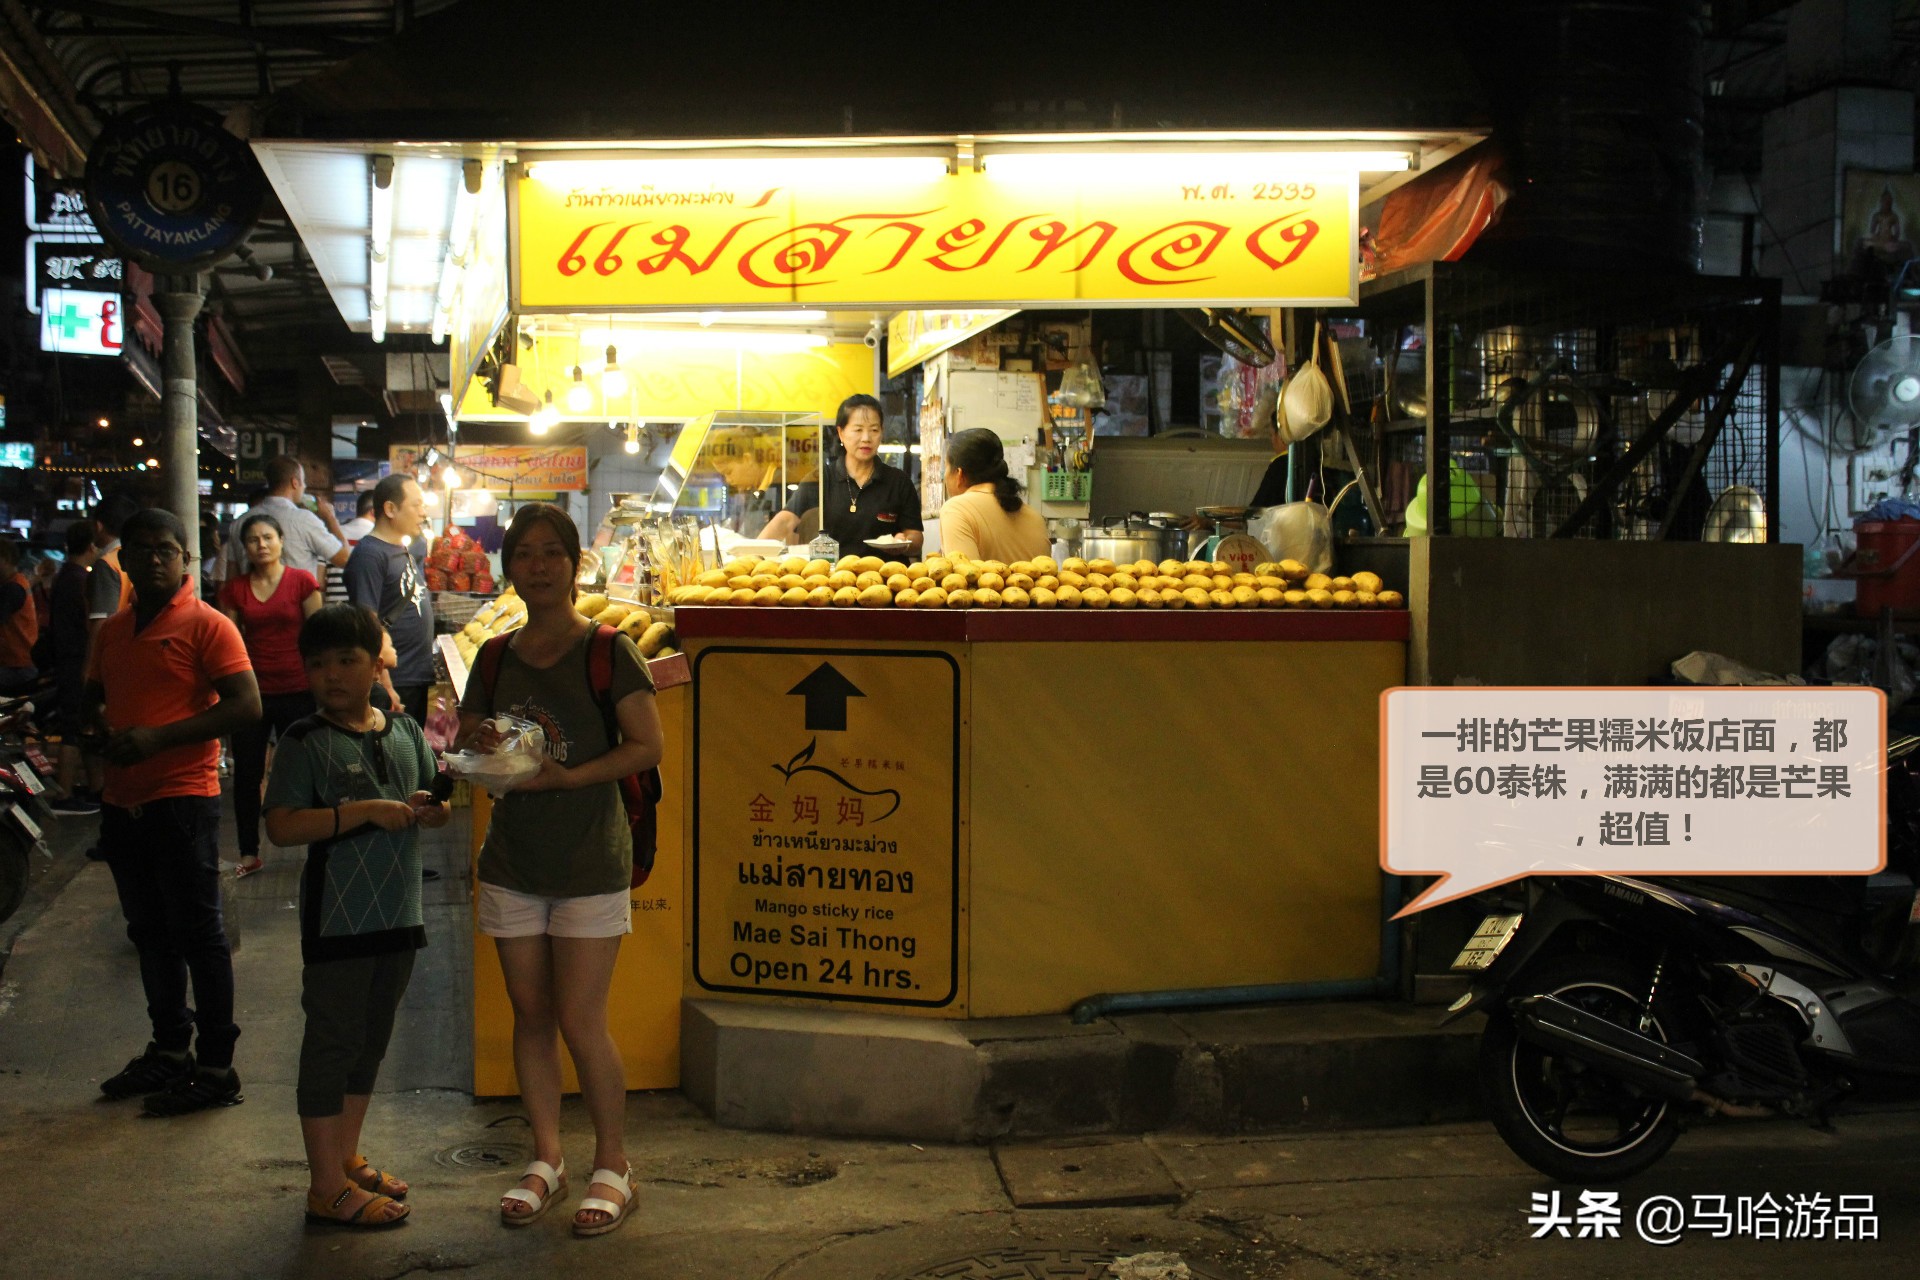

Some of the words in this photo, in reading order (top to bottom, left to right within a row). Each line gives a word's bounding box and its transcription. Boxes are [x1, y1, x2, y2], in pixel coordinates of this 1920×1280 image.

[157, 173, 192, 201] 16
[1253, 183, 1316, 200] 2535
[117, 201, 232, 245] PATTAYAKLANG
[557, 188, 1319, 288] แม่สายทอง
[749, 793, 865, 827] 金妈妈
[752, 827, 898, 854] ข้าวเหนียวมะม่วง
[738, 856, 914, 894] แม่สายทอง
[755, 899, 807, 918] Mango
[813, 903, 859, 921] sticky
[864, 905, 894, 920] rice
[733, 921, 781, 944] Mae
[790, 925, 828, 948] Sai
[836, 928, 916, 958] Thong
[730, 953, 808, 984] Open
[819, 959, 853, 984] 24
[864, 962, 921, 990] hrs.
